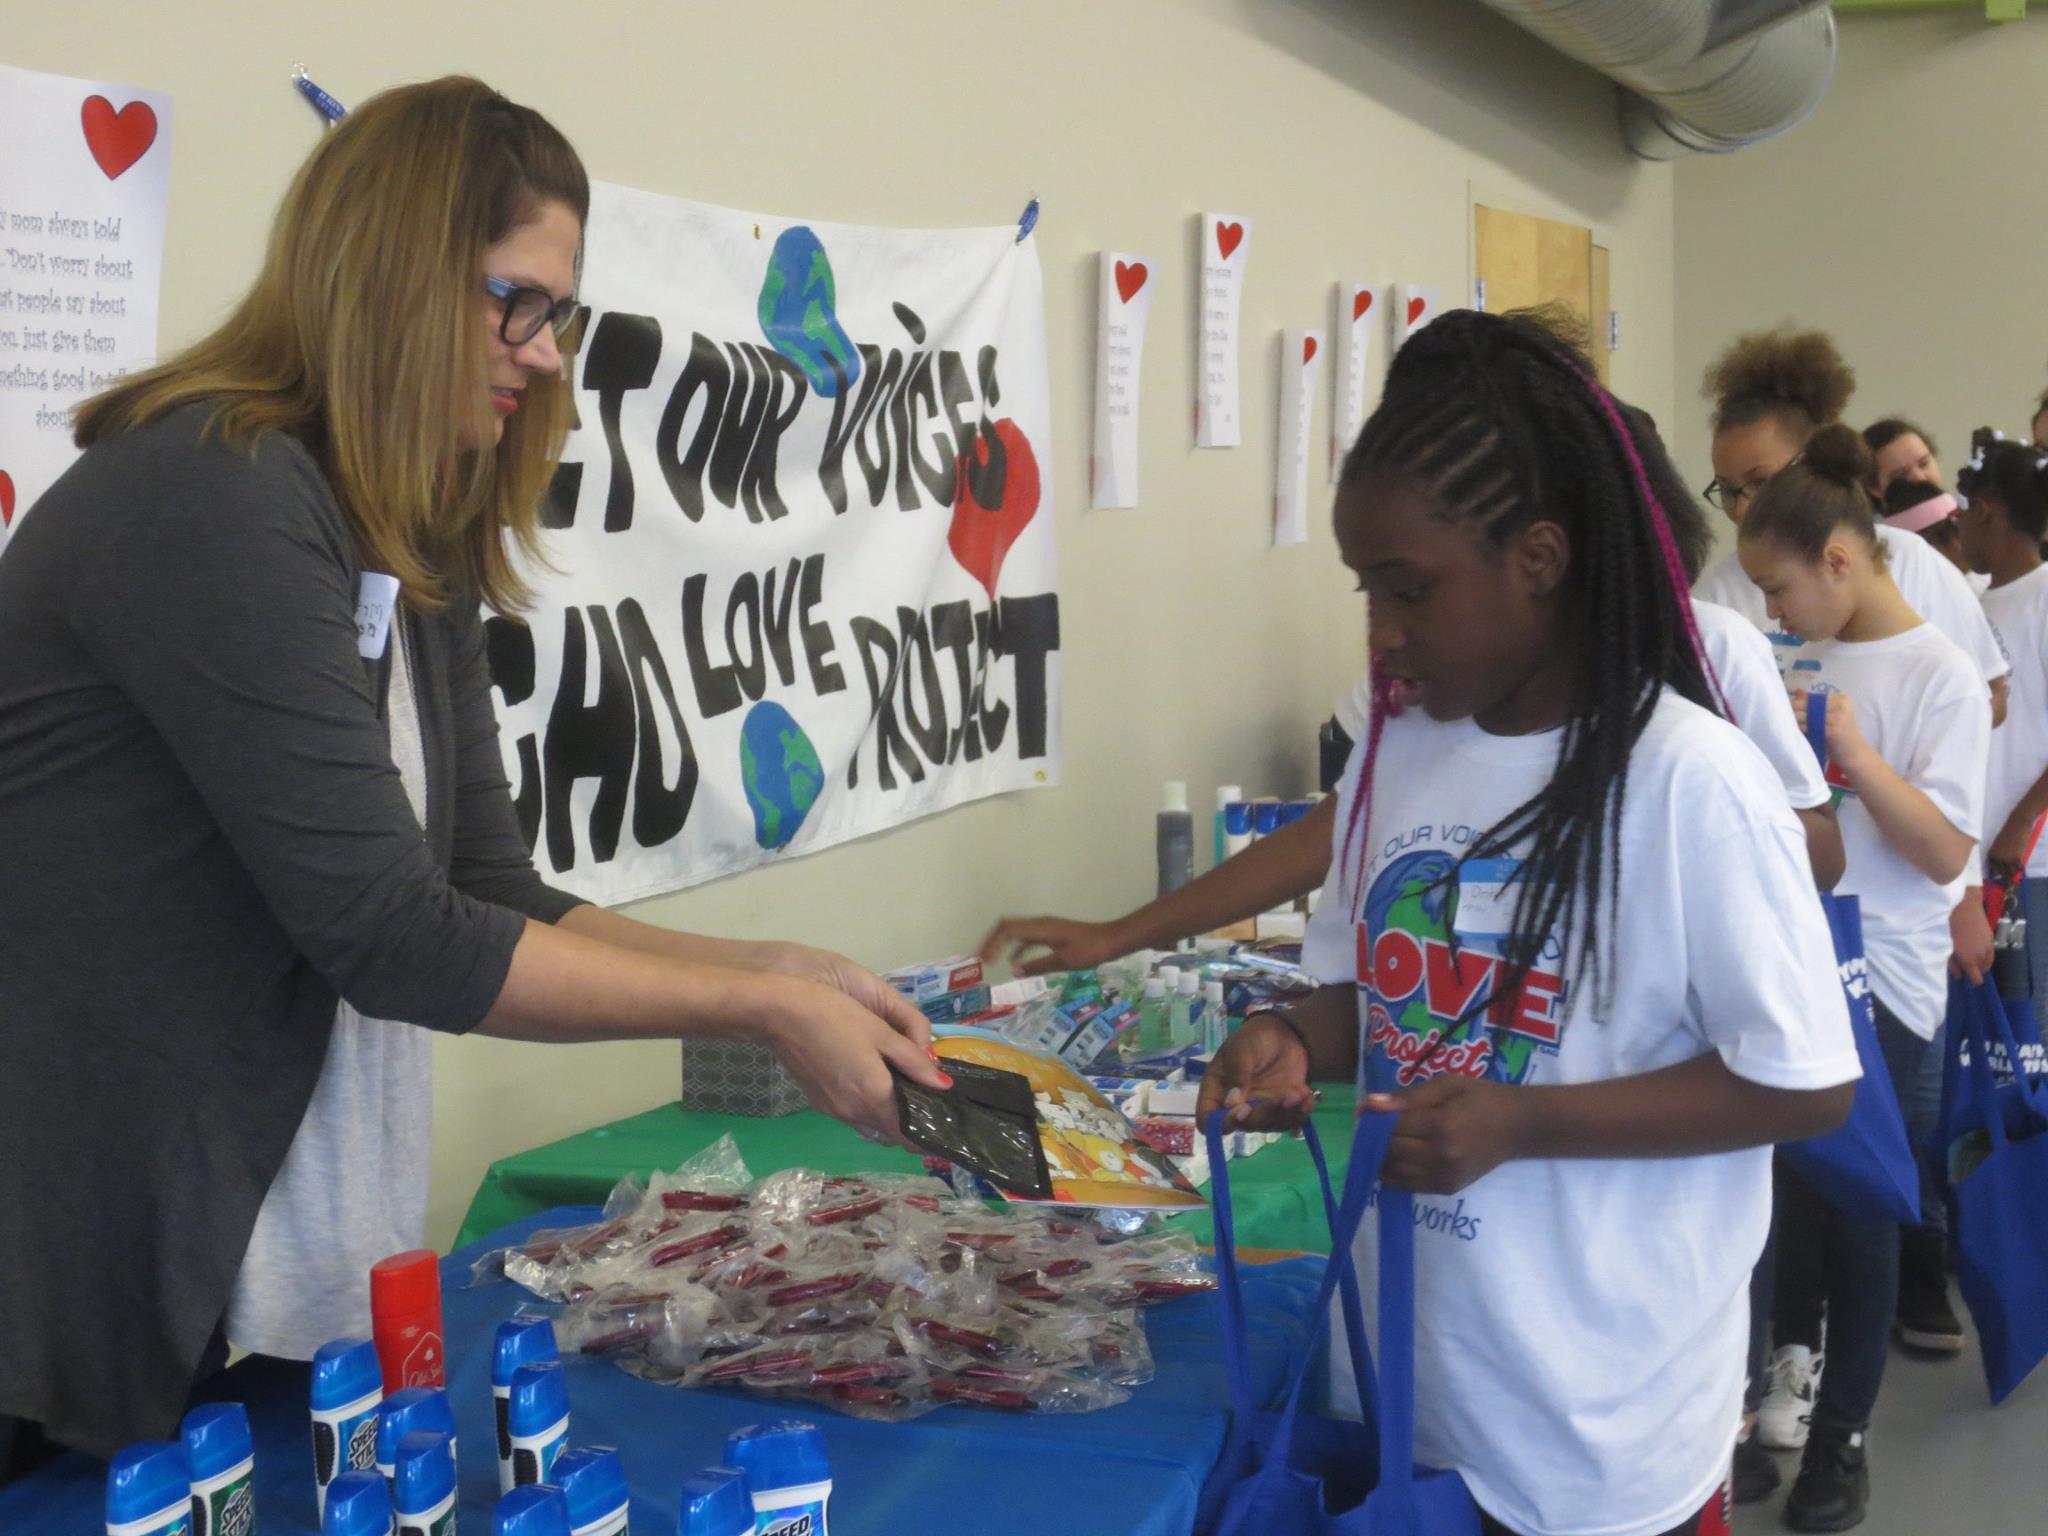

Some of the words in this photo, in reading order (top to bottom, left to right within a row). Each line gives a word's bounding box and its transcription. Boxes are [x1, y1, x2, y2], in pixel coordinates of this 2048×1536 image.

[94, 217, 121, 242] told
[94, 254, 134, 281] about
[17, 288, 61, 314] people
[90, 290, 126, 317] about
[23, 326, 48, 352] just
[52, 330, 79, 353] give
[84, 328, 116, 353] them
[53, 366, 85, 392] good
[657, 331, 807, 524] OUR
[682, 553, 847, 719] LOVE
[1384, 825, 1433, 859] OUR
[1356, 920, 1563, 1045] LOVE
[1367, 1003, 1492, 1086] Project
